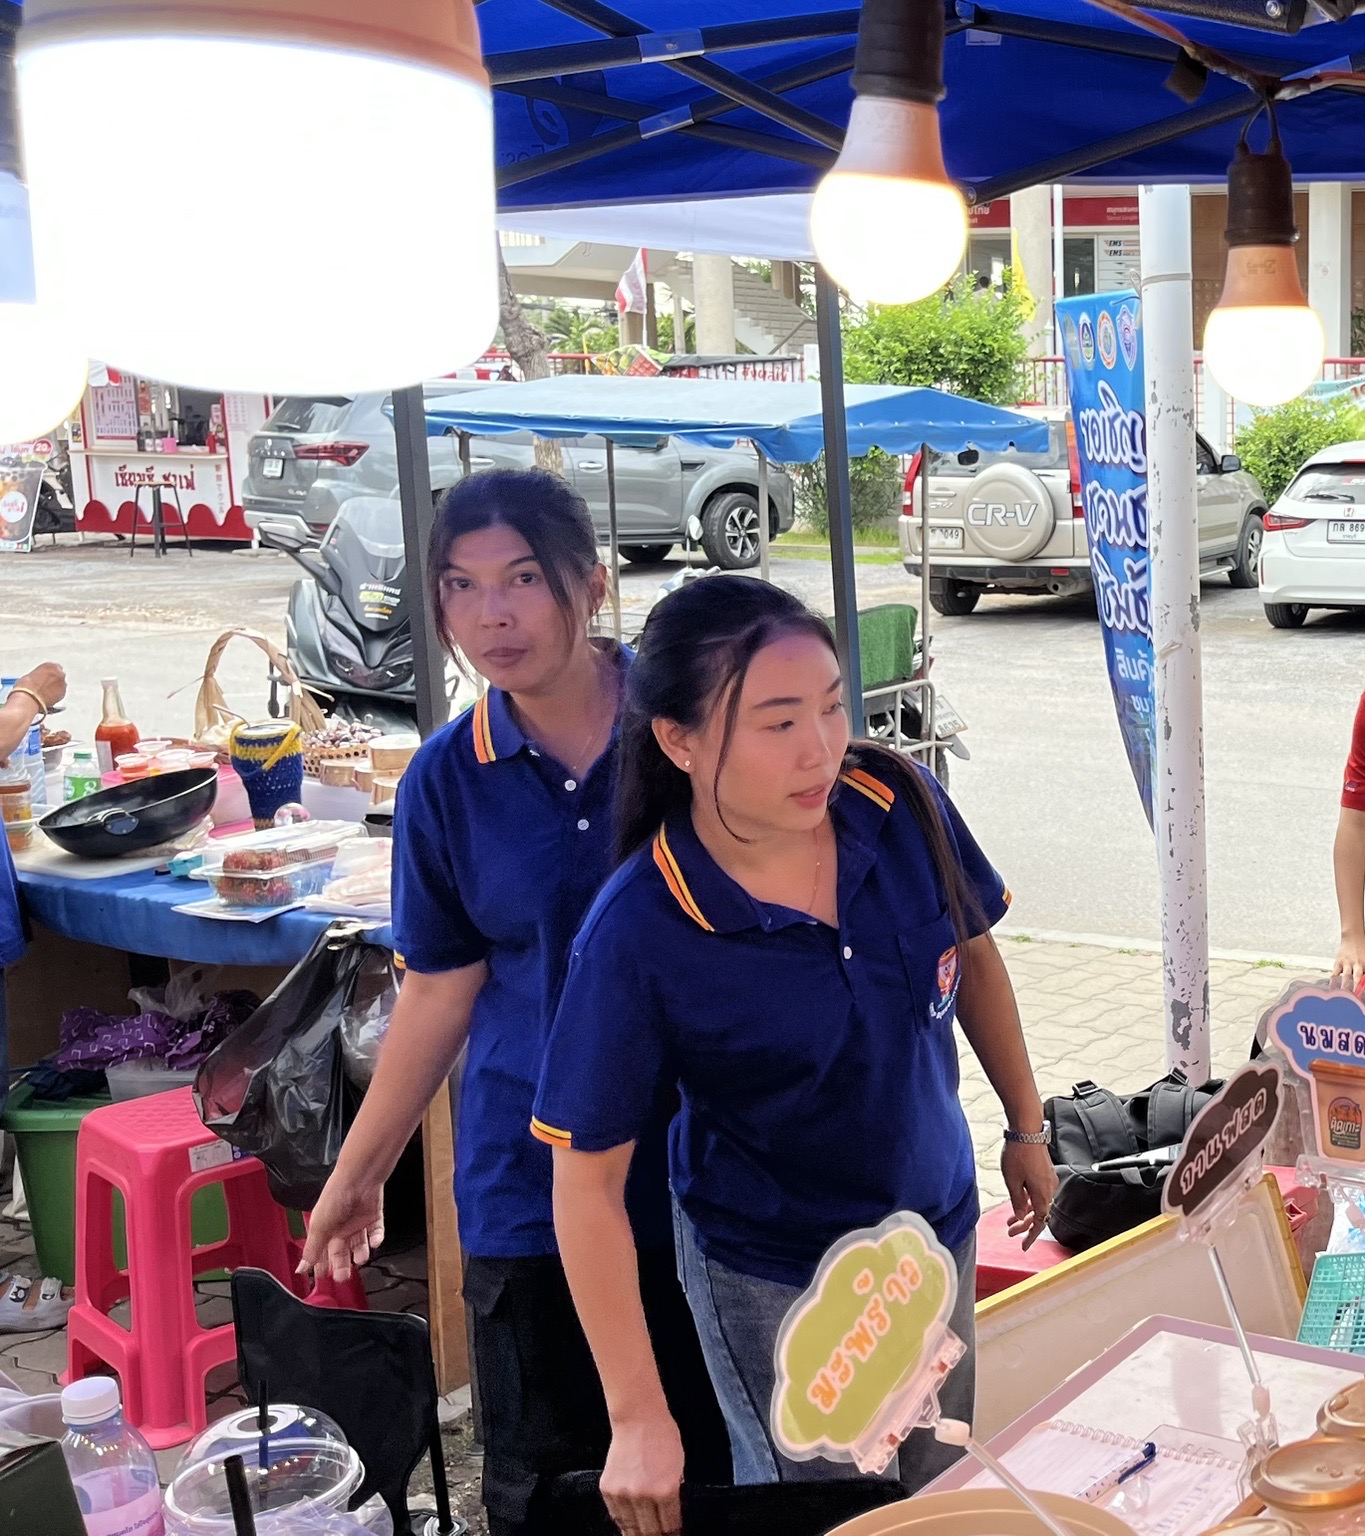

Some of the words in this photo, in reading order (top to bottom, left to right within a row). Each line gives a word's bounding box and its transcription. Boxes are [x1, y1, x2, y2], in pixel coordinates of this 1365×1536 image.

[1080, 380, 1147, 474] ขอเชิญ
[967, 503, 1038, 527] CR-V
[1115, 647, 1152, 682] สินค้
[1180, 1087, 1267, 1196] กาแฟสด
[808, 1255, 922, 1413] มะพร้าว
